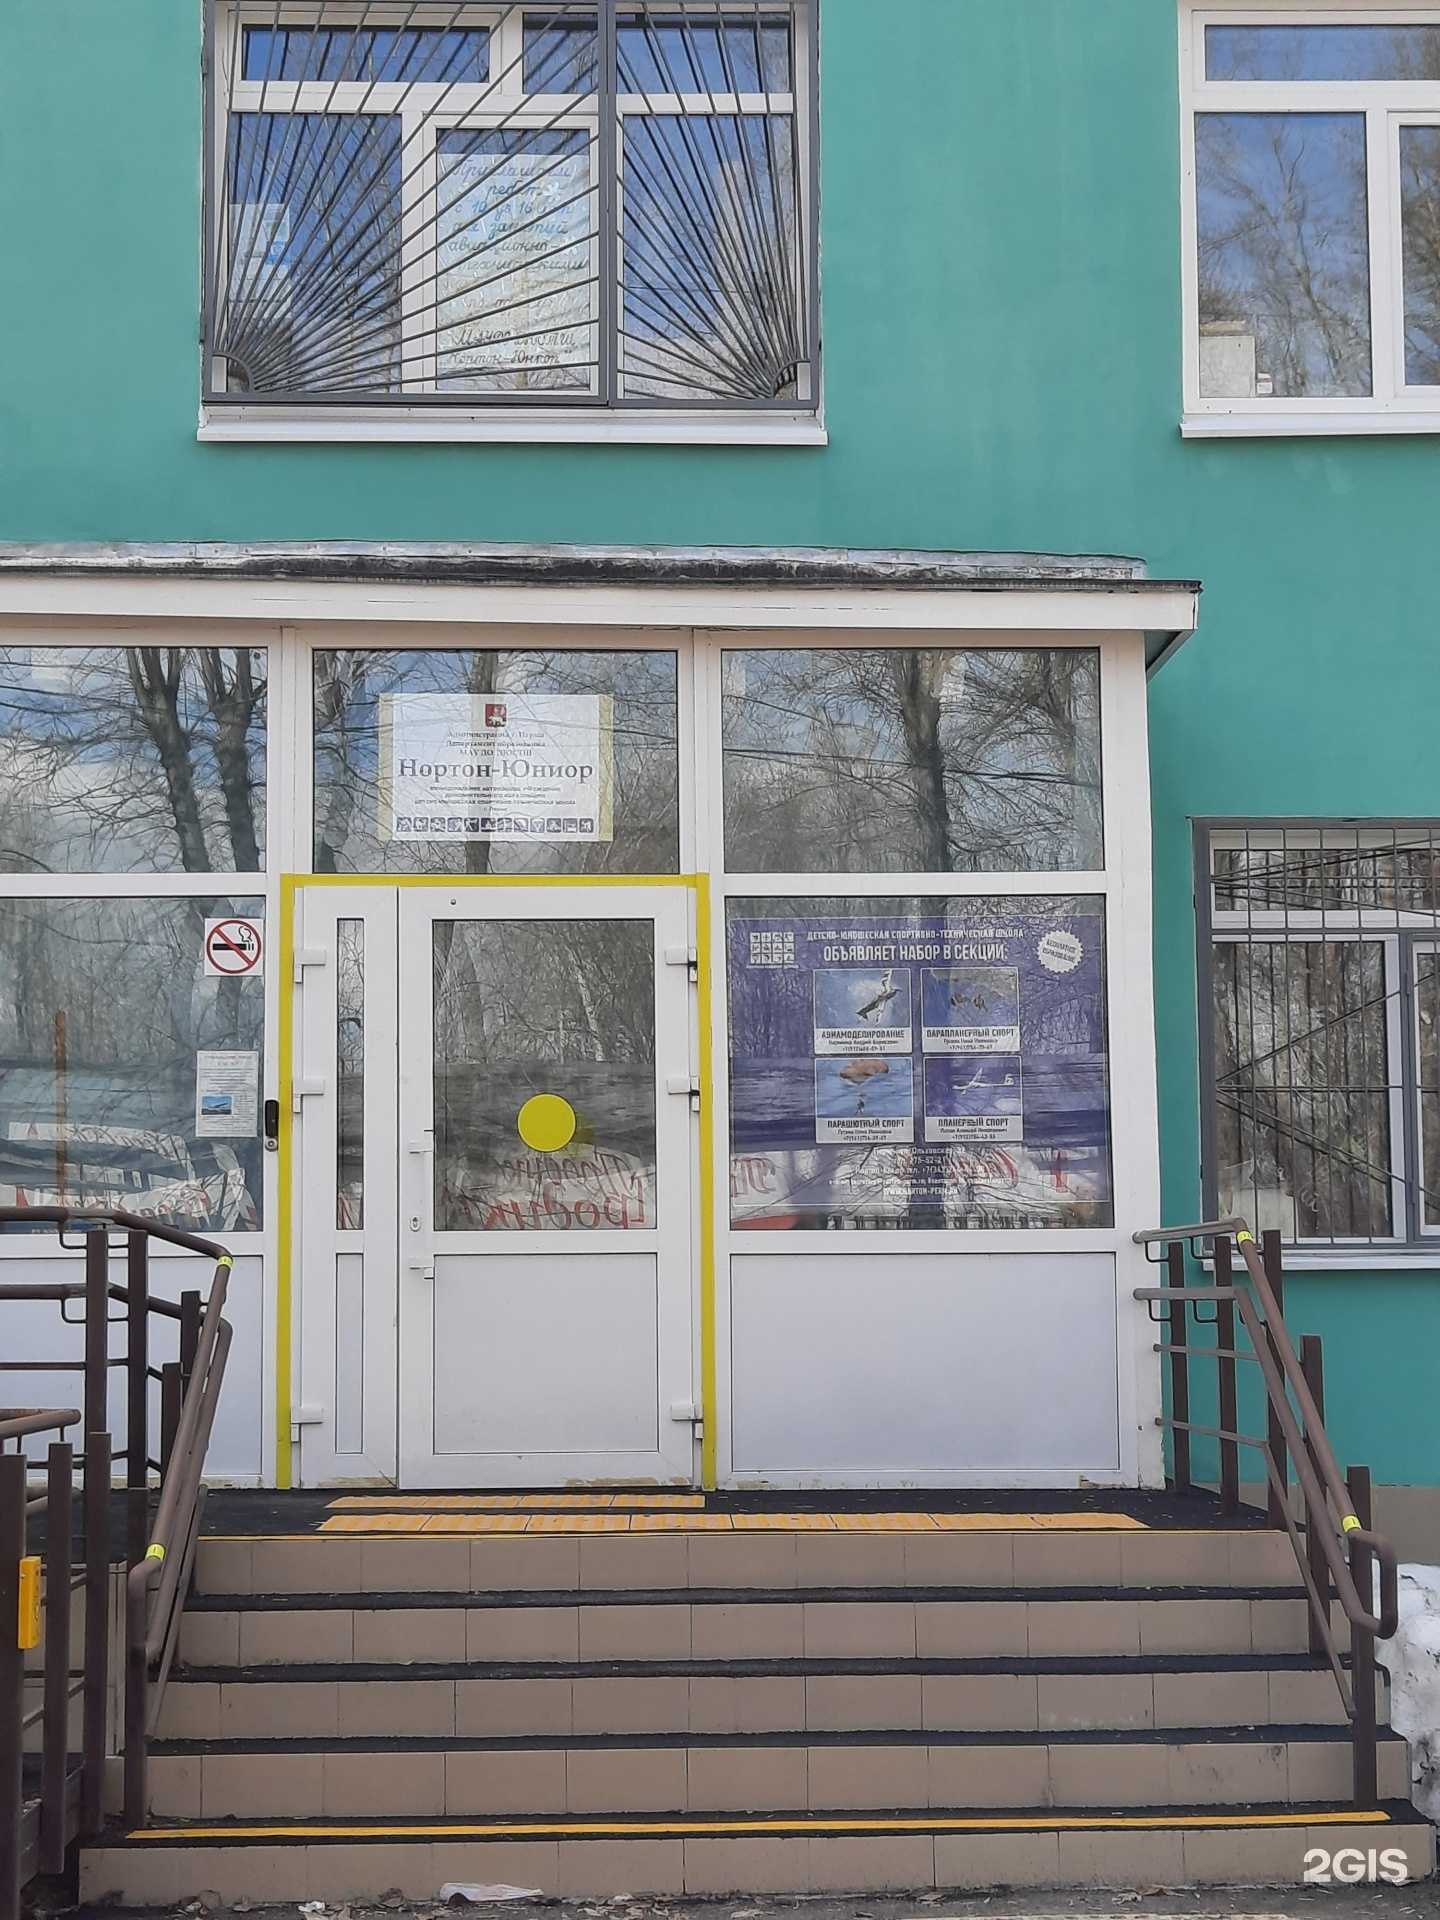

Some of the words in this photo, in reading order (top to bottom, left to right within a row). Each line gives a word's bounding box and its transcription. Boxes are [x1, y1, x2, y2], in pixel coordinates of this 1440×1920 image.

[398, 758, 593, 784] Нортон-Юниор
[823, 945, 897, 962] ОБЪЯВЛЯЕТ
[900, 944, 940, 961] НАБОР
[943, 945, 952, 961] В
[882, 1119, 904, 1128] СПОРТ
[985, 1118, 1008, 1127] СПОРТ
